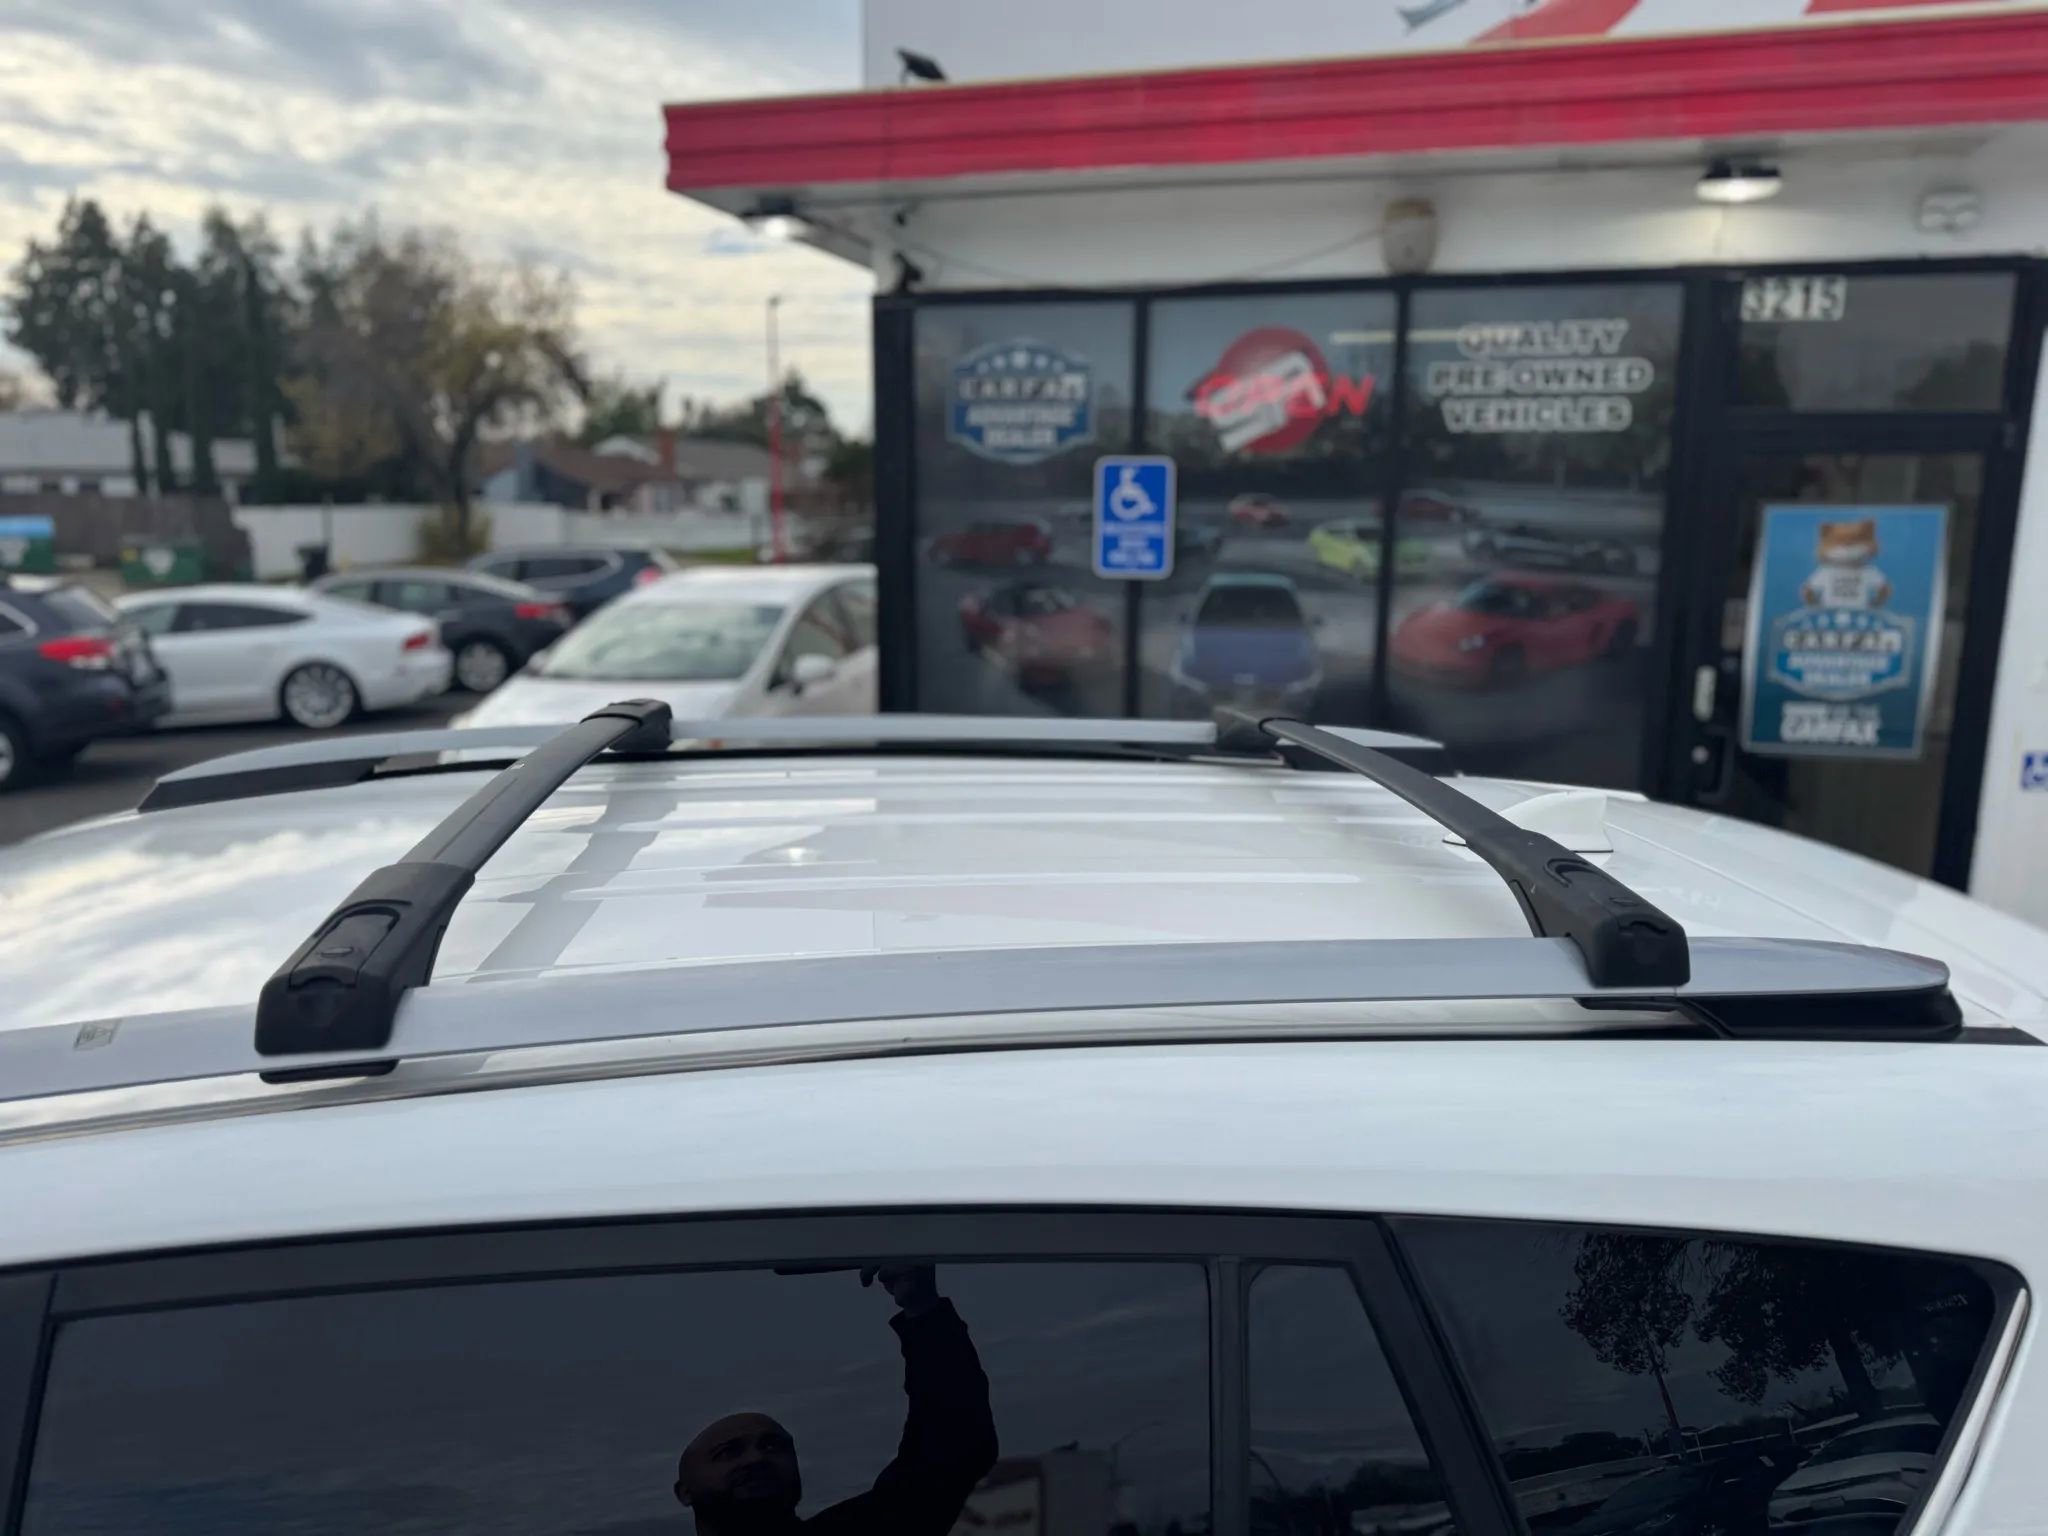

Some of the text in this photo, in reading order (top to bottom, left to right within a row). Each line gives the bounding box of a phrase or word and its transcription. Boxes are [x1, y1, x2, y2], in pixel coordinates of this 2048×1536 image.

[1741, 275, 1848, 321] 3215
[1457, 318, 1629, 361] QUALITY
[1441, 395, 1632, 433] VEHICLES
